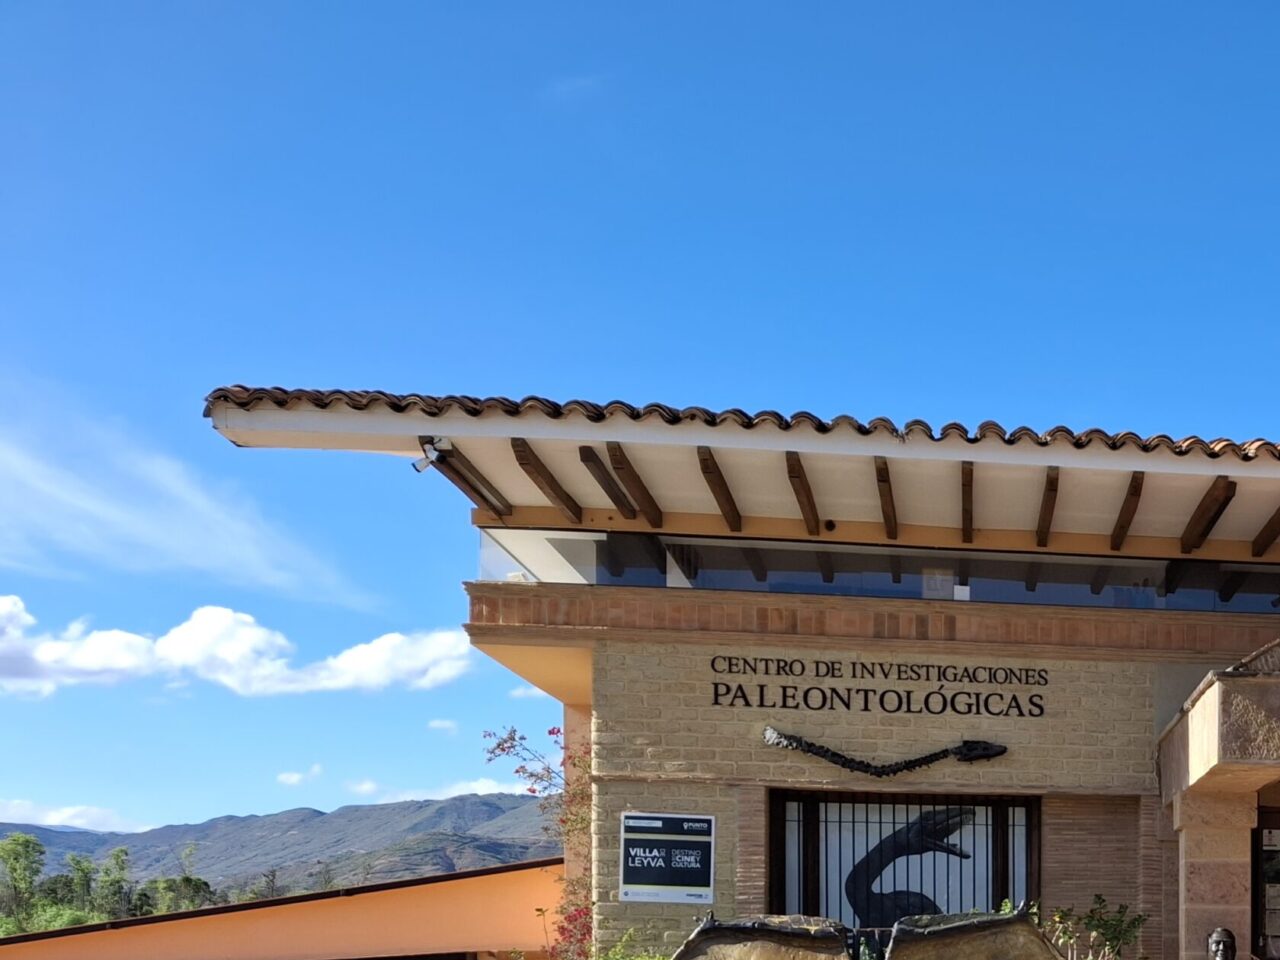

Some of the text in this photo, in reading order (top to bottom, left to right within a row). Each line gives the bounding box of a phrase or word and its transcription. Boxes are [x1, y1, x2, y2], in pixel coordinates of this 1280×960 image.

[711, 656, 1049, 687] CENTRO DE INVESTIGACIONES
[711, 682, 1045, 718] PALEONTOLÓGICAS
[628, 857, 665, 868] LEYVA
[629, 847, 660, 857] VILLA
